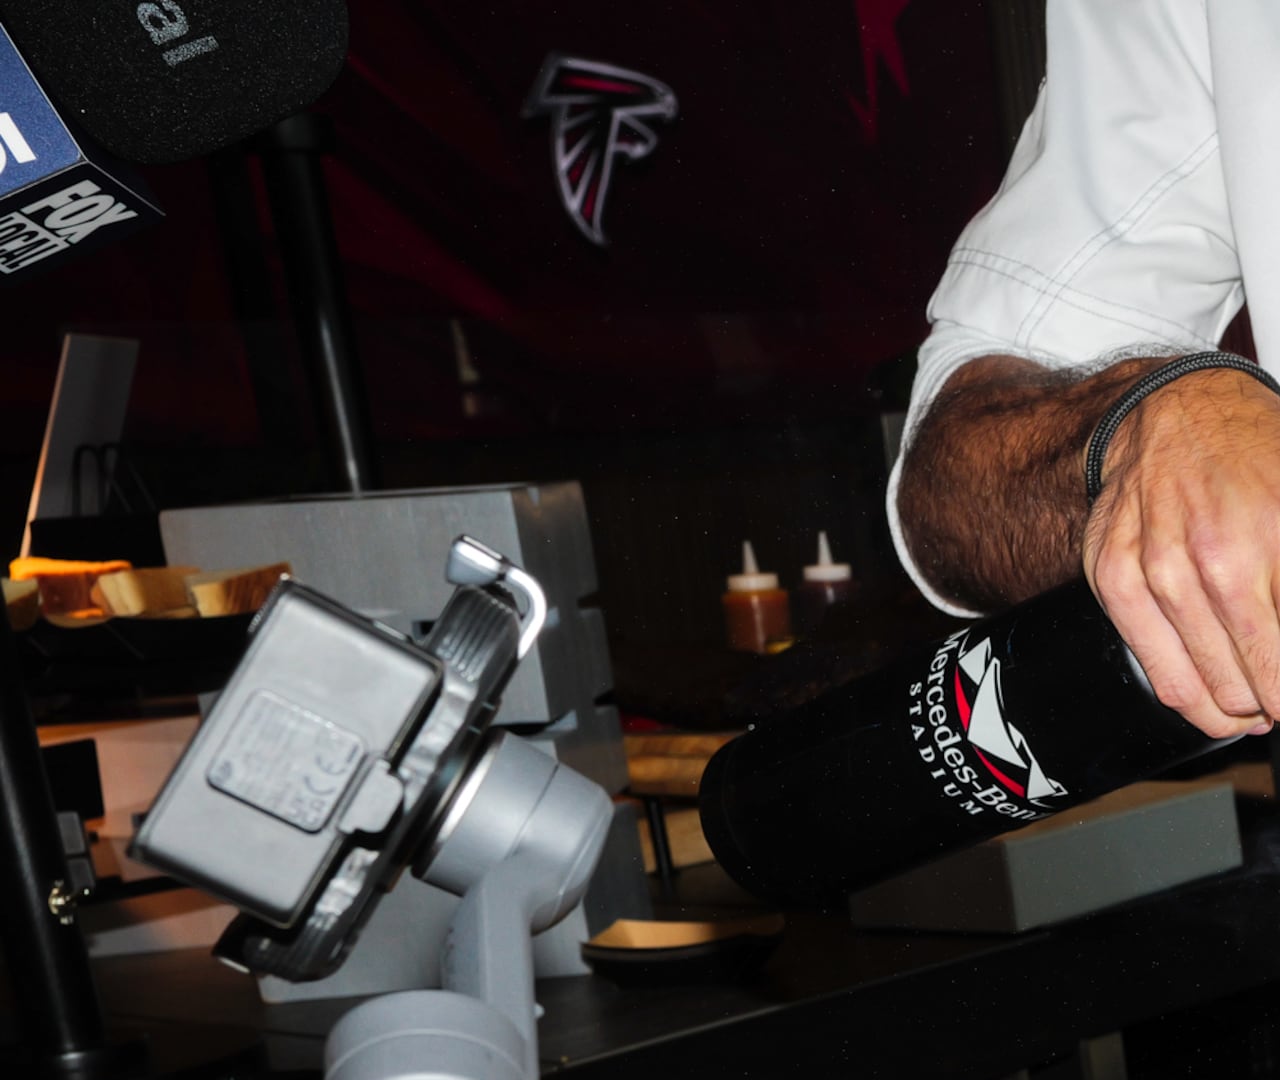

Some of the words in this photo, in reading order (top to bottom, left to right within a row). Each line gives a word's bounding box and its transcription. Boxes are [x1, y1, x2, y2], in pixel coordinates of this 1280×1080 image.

[20, 179, 138, 244] FOX
[909, 681, 984, 816] STADIUM
[925, 626, 1053, 823] Mercedes-Ben
